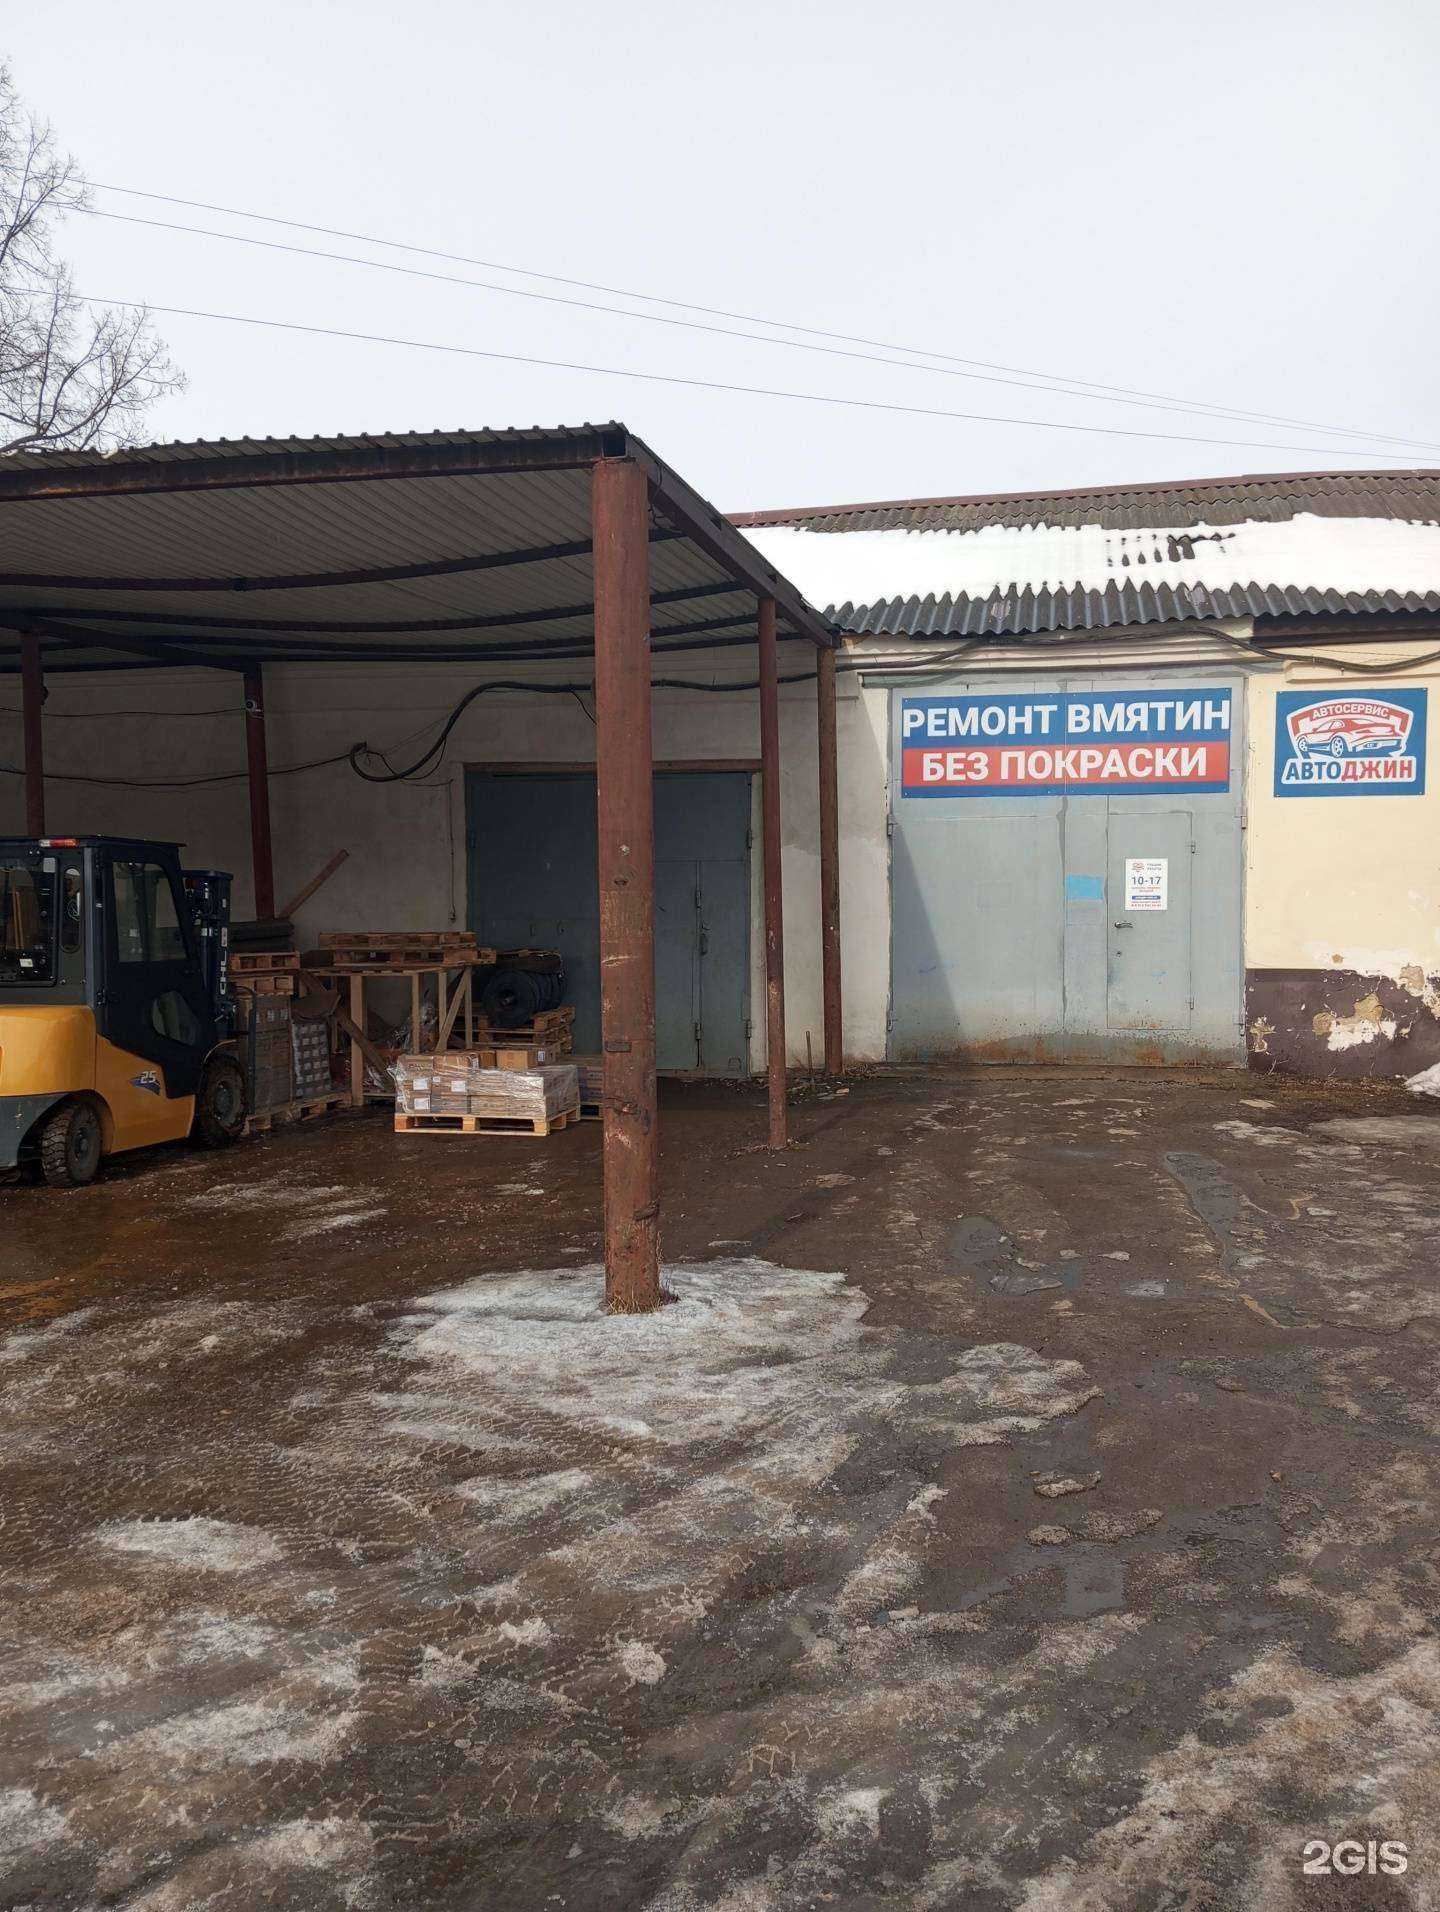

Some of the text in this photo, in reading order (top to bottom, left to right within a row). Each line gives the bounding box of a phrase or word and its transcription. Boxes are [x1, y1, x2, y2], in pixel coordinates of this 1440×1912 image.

[903, 700, 1230, 738] РЕМОНТ ВМЯТИН
[1312, 703, 1390, 720] АВТОСЕРВИС
[922, 747, 1207, 782] БЕЗ ПОКРАСКИ
[1285, 759, 1413, 782] АВТОДЖИН
